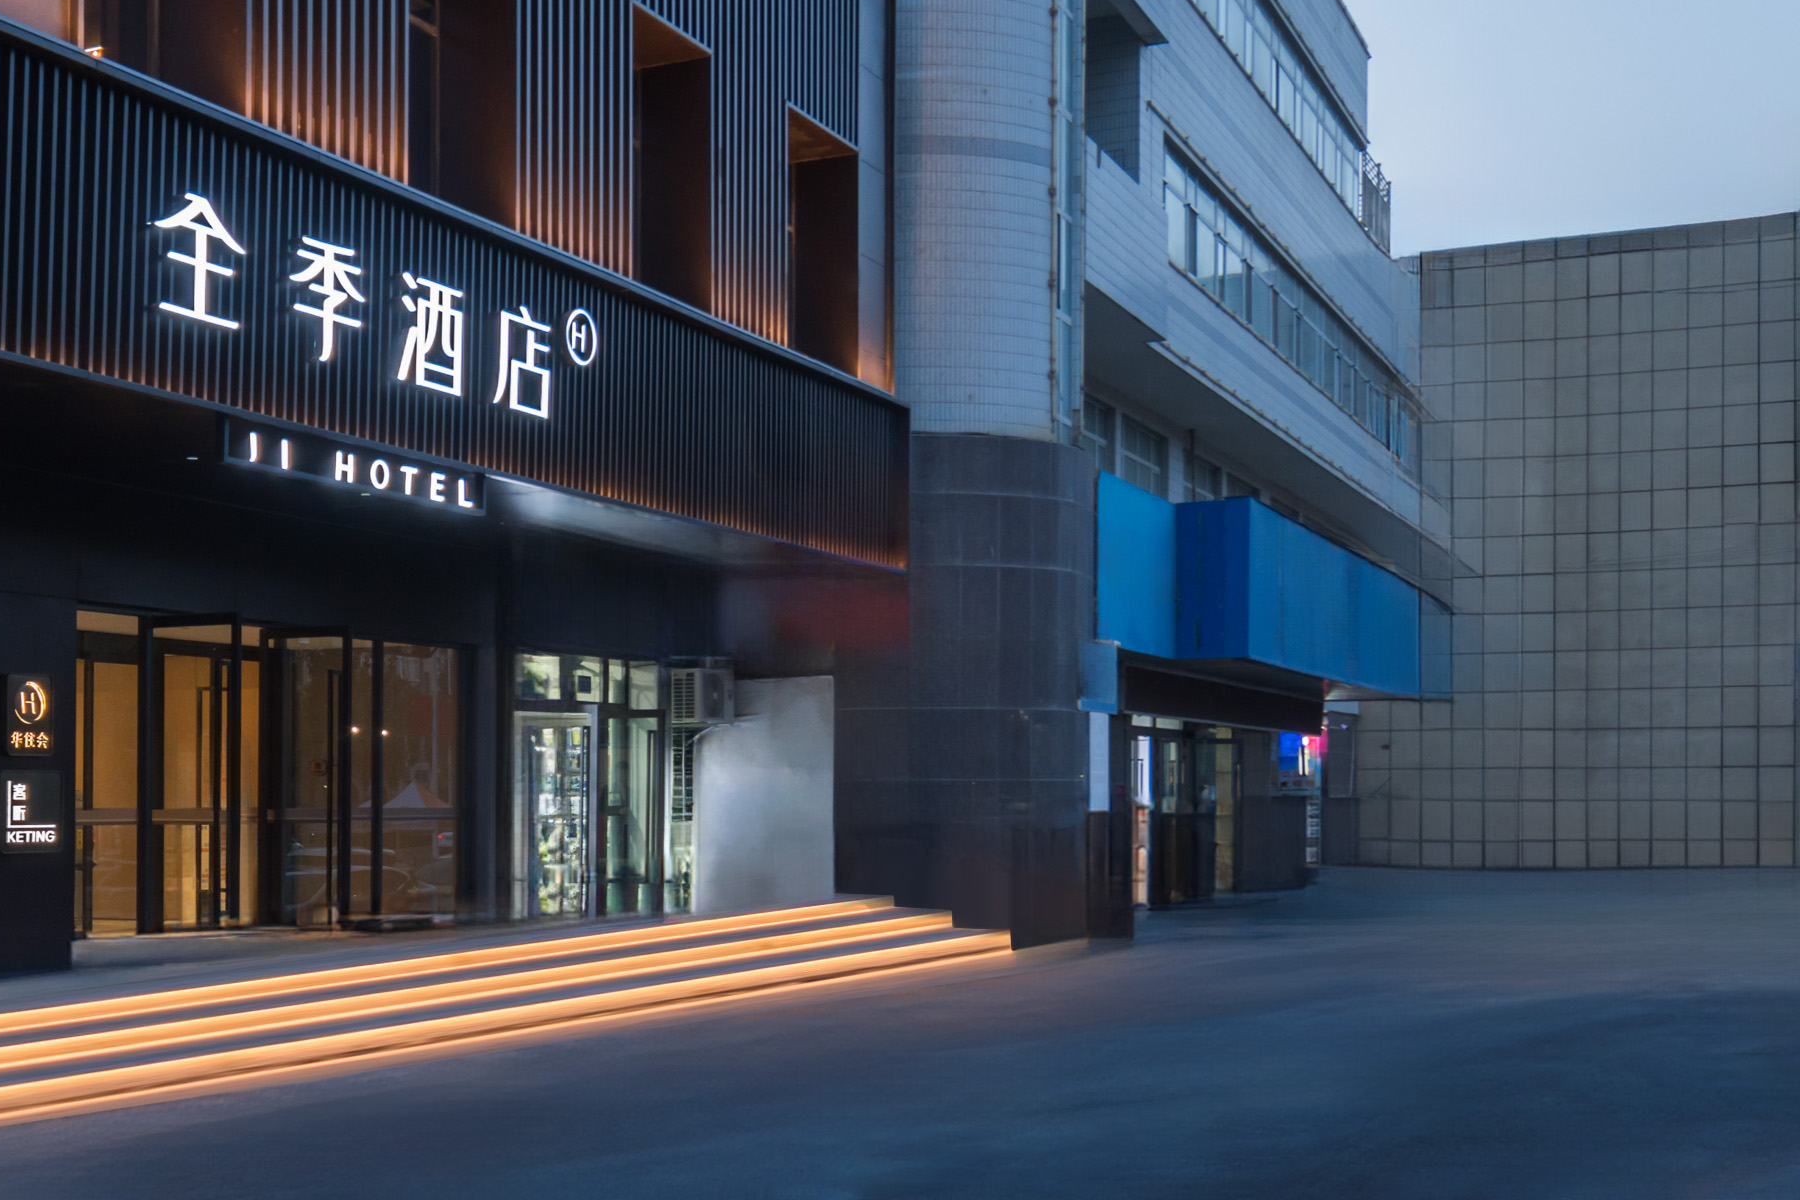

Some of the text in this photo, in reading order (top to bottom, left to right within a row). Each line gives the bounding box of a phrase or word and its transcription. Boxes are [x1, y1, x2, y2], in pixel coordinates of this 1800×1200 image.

[155, 192, 552, 419] 全季酒店
[249, 431, 474, 508] JI HOTEL
[6, 830, 57, 844] KETING
